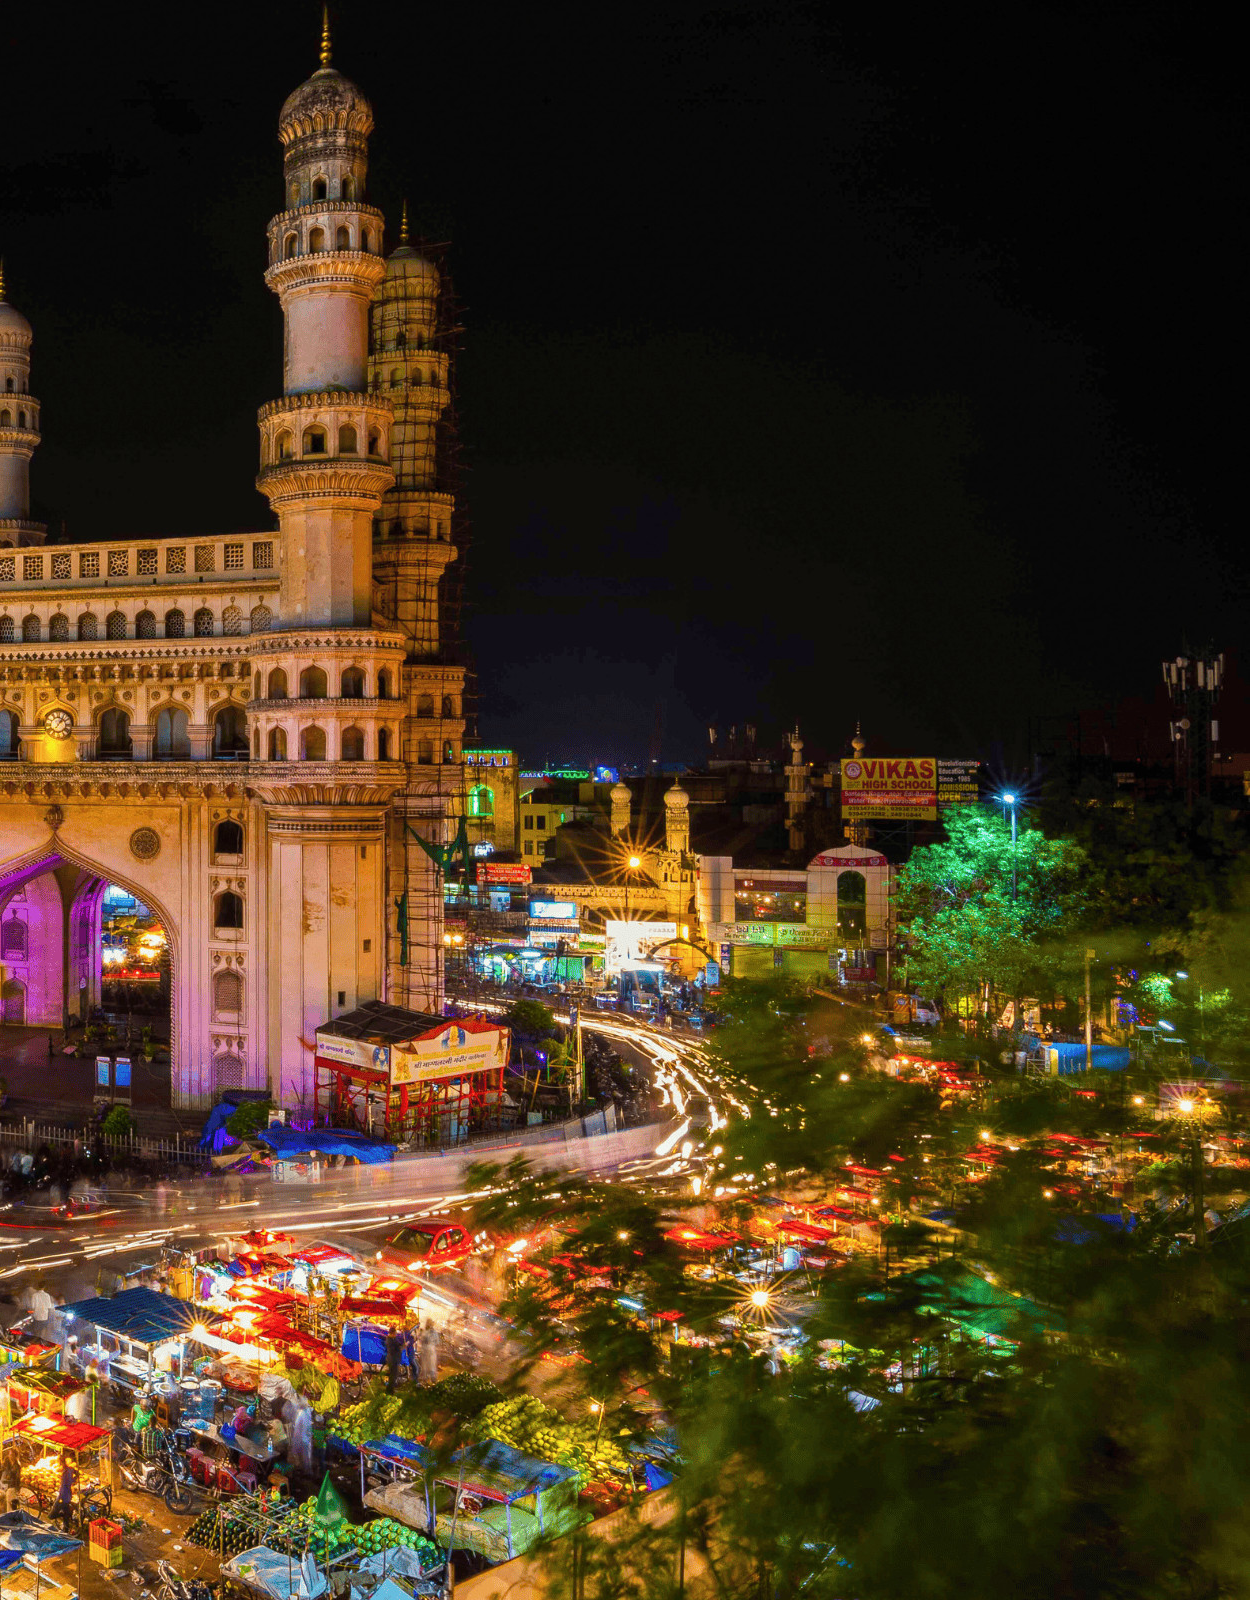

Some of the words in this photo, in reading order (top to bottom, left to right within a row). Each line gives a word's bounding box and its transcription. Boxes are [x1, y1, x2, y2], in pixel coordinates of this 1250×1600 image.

[862, 760, 934, 779] VIKAS
[862, 781, 887, 789] HIGH
[891, 781, 934, 789] SCHOOL
[938, 792, 960, 801] OPEN
